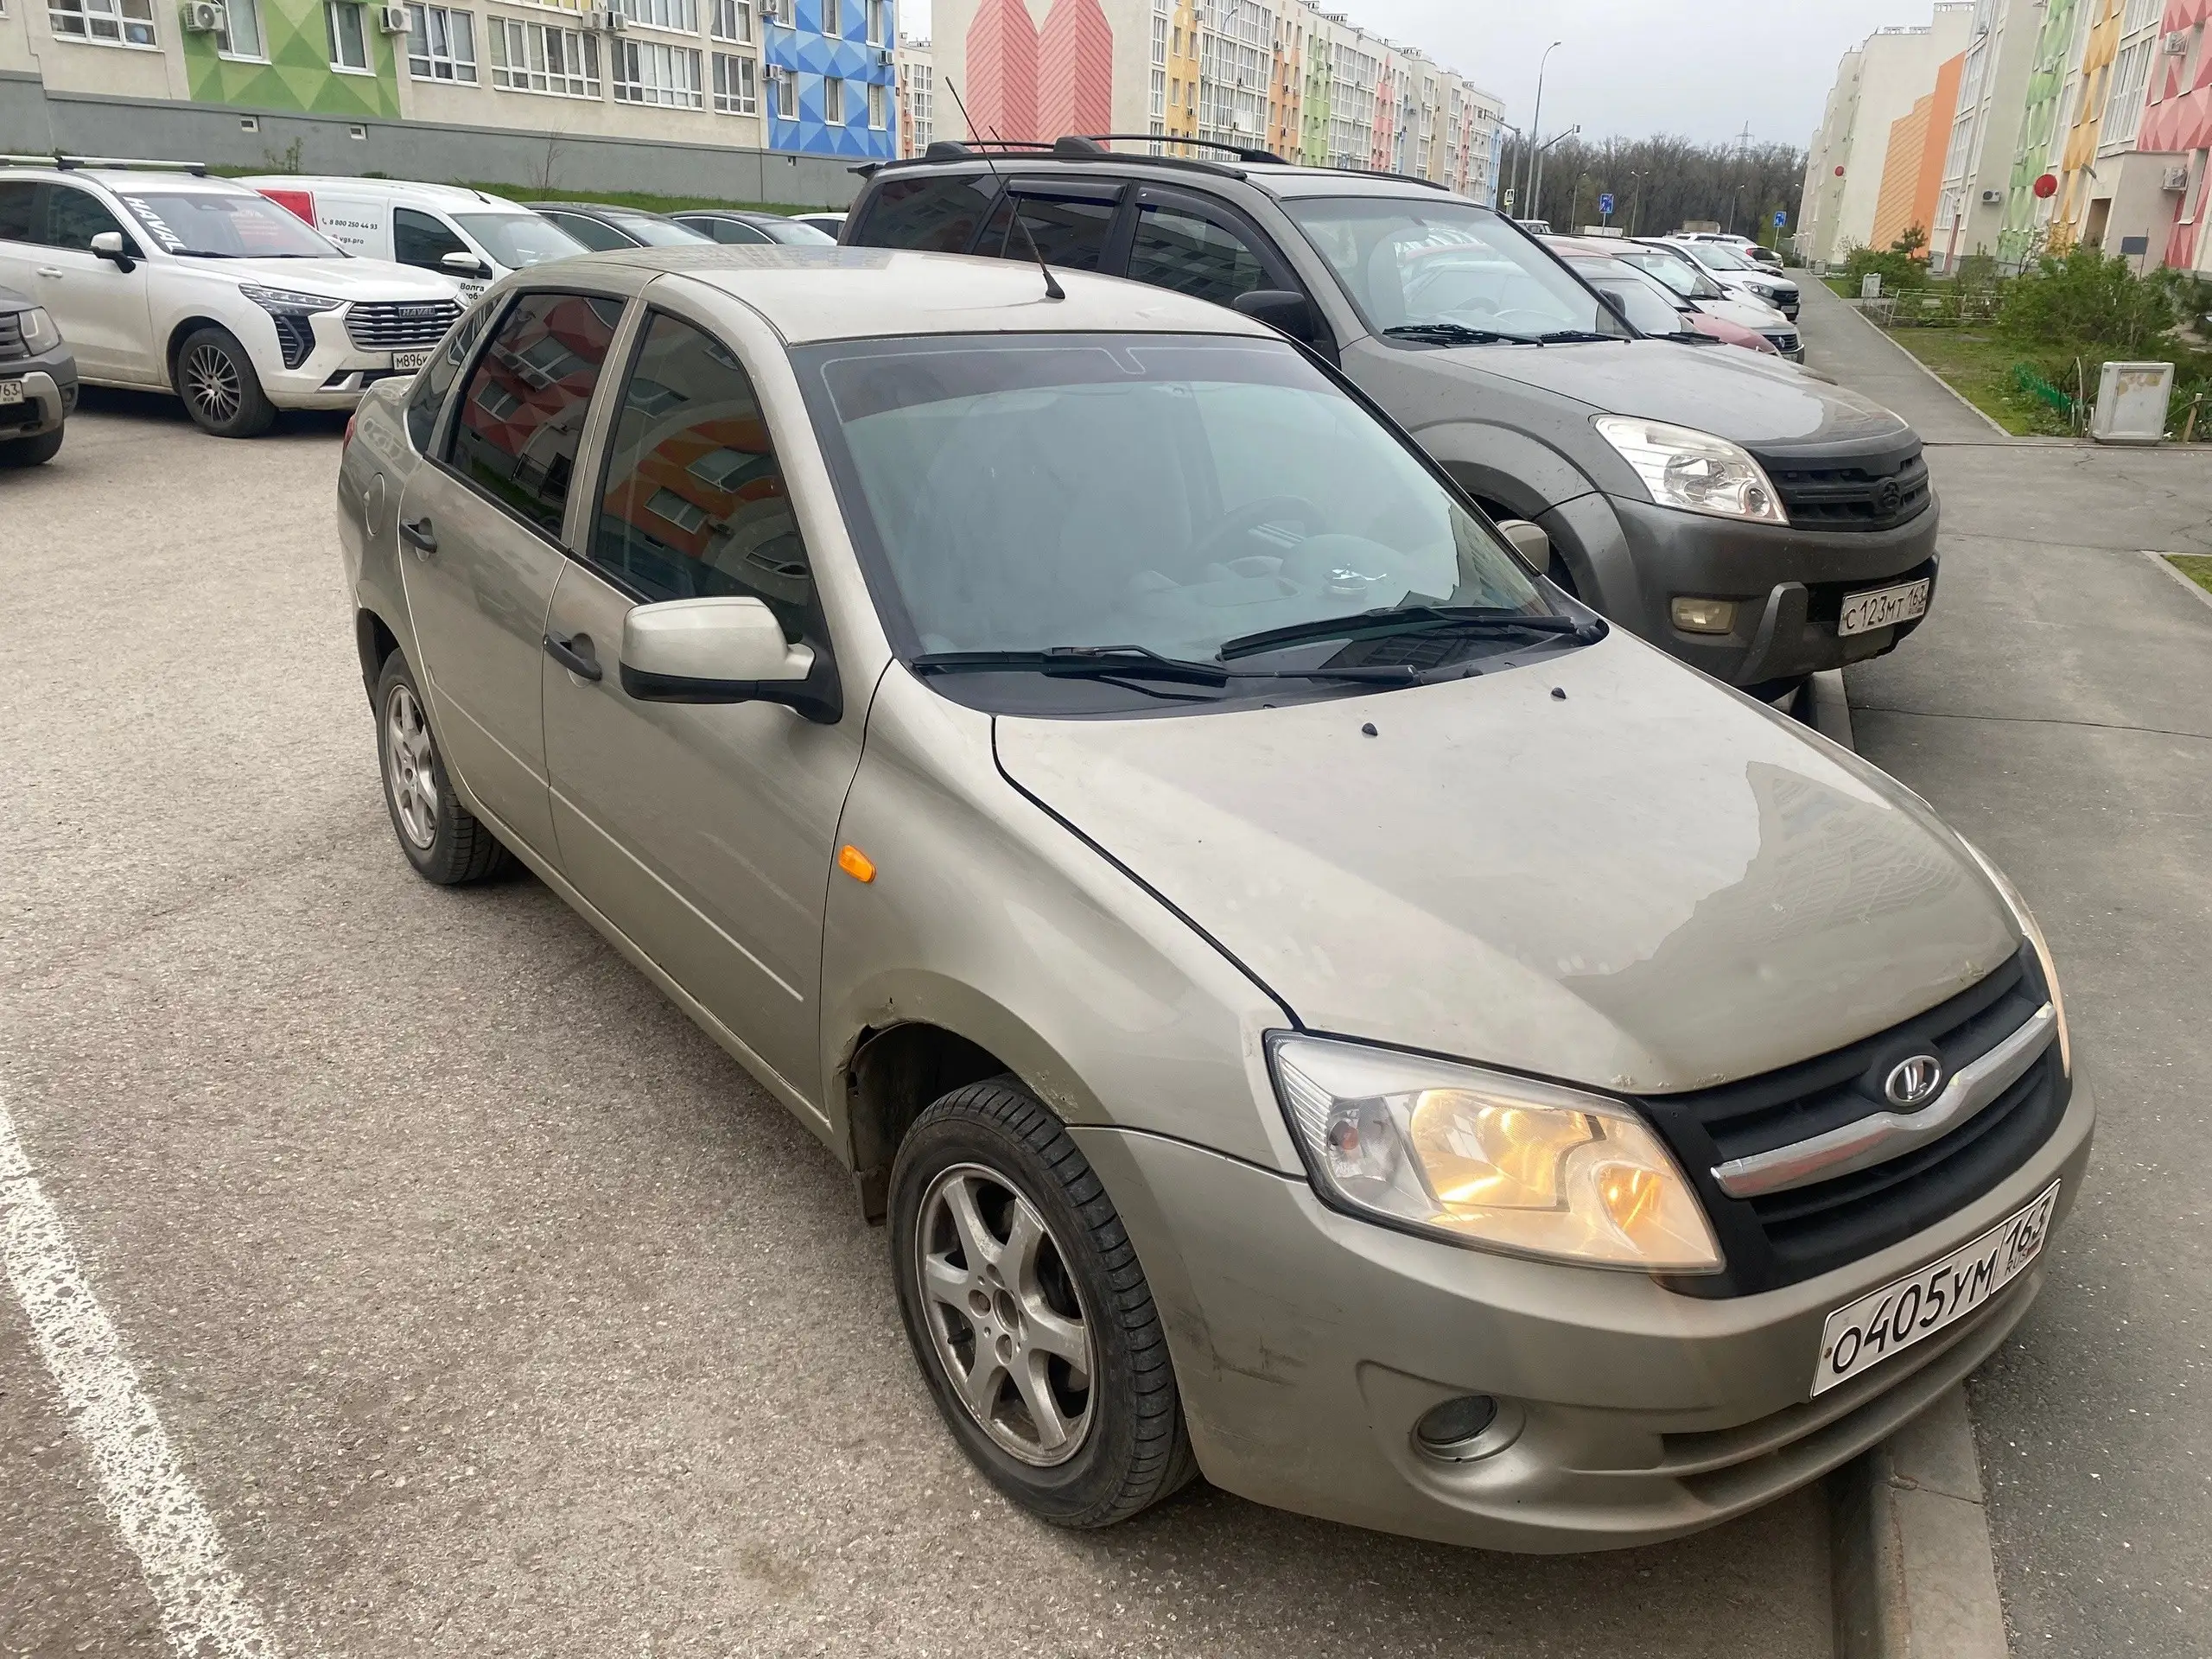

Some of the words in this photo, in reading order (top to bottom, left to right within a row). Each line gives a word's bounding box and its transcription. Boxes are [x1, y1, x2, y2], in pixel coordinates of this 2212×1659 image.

[123, 196, 187, 252] HAVAL
[340, 236, 364, 245] vgs.pro
[460, 283, 485, 292] Волга
[402, 308, 435, 316] HAVAL
[1847, 595, 1904, 629] С123МТ
[1908, 585, 1927, 607] 163
[1832, 1248, 1998, 1375] О405УМ
[2005, 1195, 2051, 1262] 163
